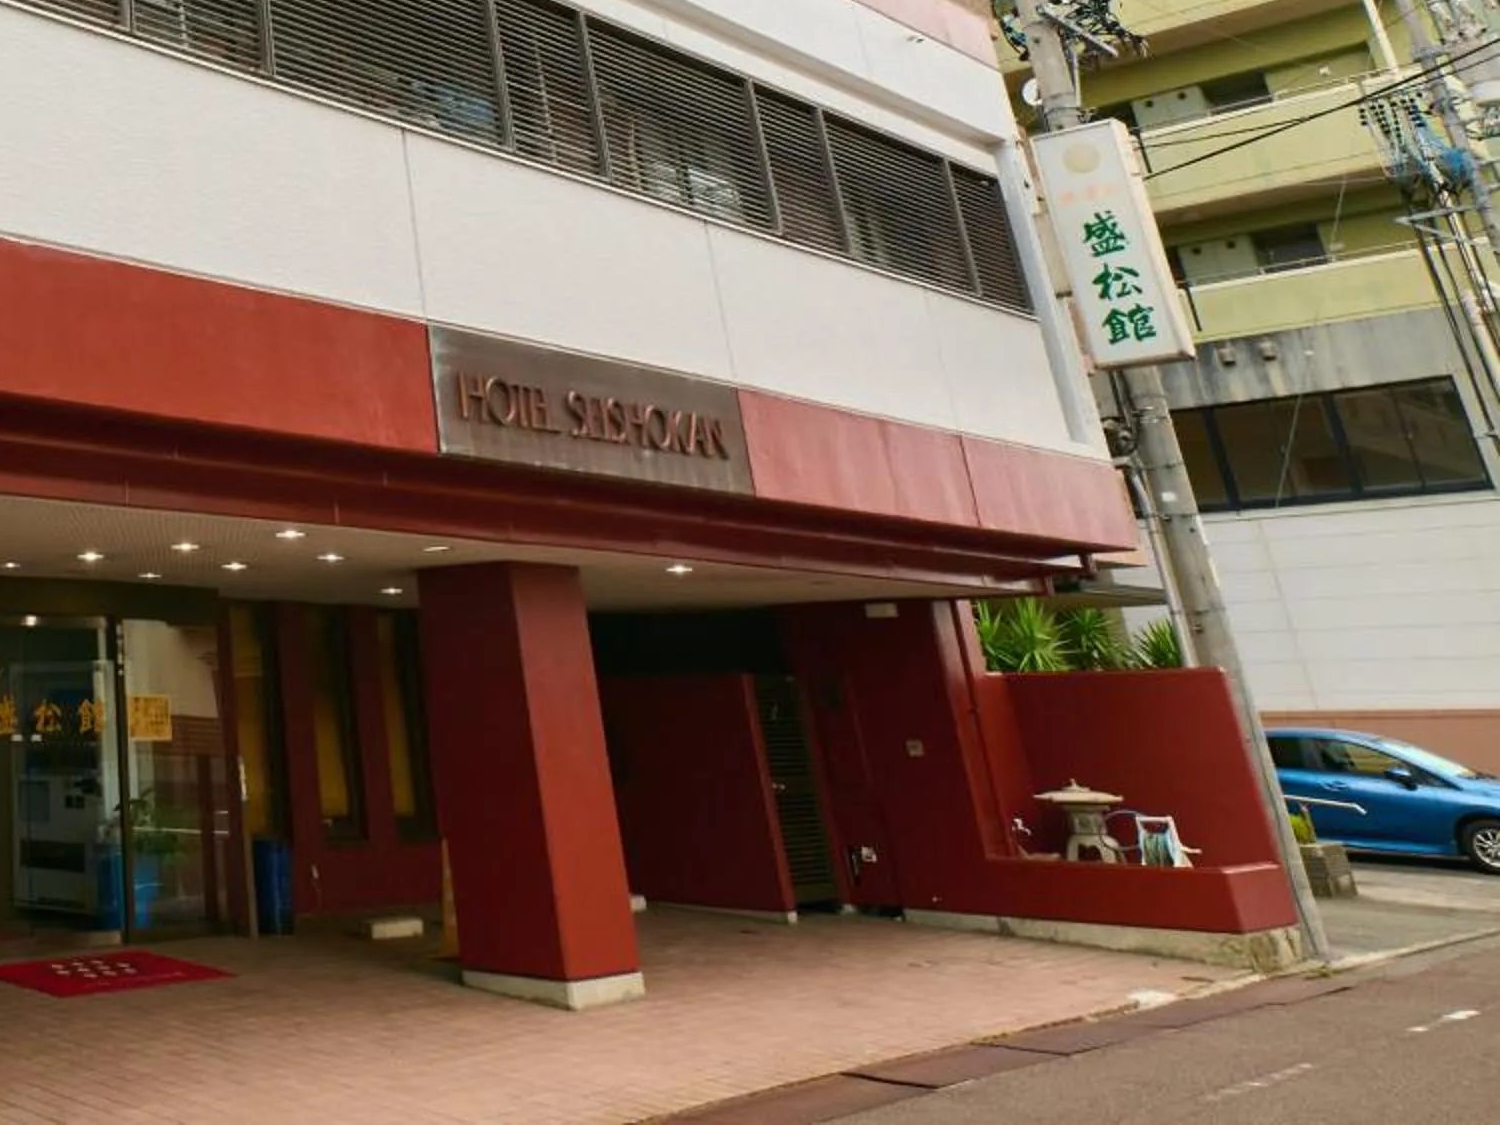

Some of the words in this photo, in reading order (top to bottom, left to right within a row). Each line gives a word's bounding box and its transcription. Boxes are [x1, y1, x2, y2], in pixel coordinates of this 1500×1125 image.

[1083, 210, 1156, 345] 盛松館
[456, 371, 561, 435] HOTEL
